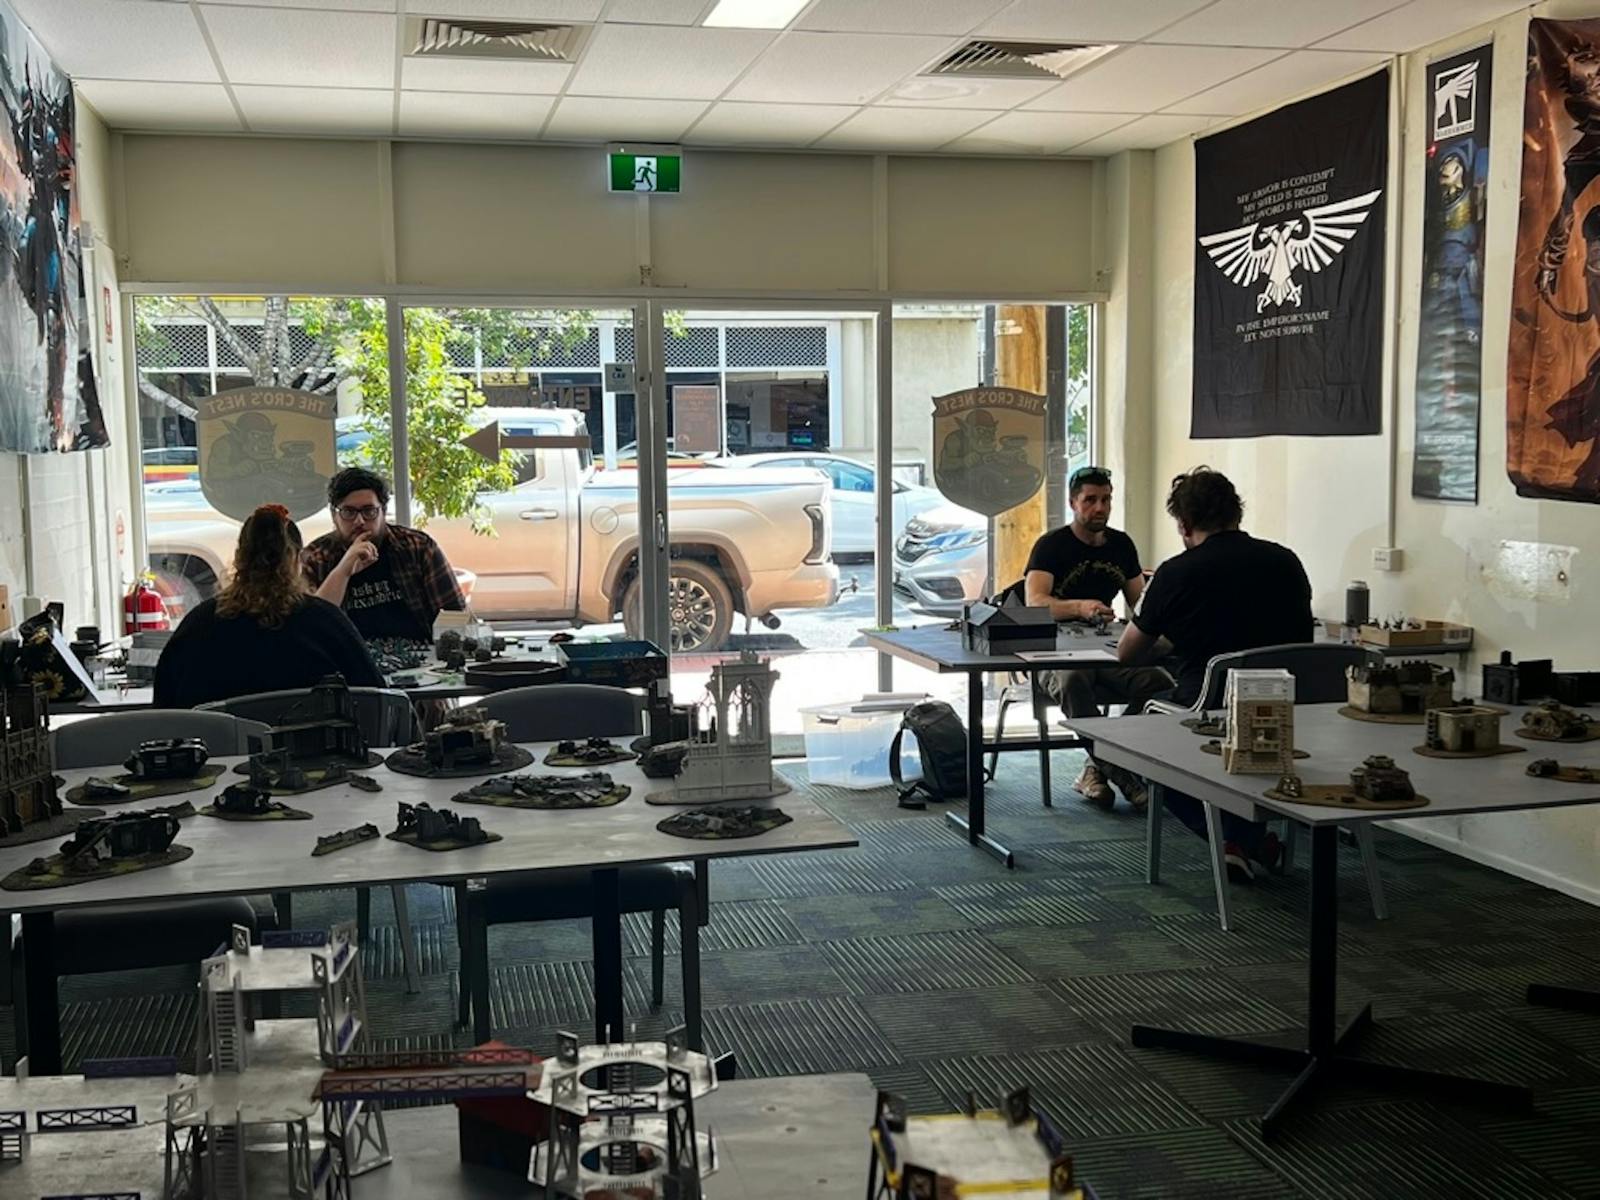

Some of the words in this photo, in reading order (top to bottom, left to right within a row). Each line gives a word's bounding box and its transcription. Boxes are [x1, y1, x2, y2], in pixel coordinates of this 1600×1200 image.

[1282, 180, 1289, 189] IS
[1290, 167, 1335, 187] CONTEMPT
[1243, 202, 1256, 213] MY
[1257, 191, 1284, 209] SHIELD
[1285, 190, 1292, 199] IS
[1293, 181, 1328, 198] DISGUST
[1242, 213, 1255, 225] MY
[1256, 203, 1285, 220] SWORD
[1286, 201, 1293, 211] IS
[1294, 193, 1329, 209] HATRED
[1236, 323, 1245, 333] IN
[1304, 310, 1331, 322] NAME
[1259, 328, 1281, 339] NONE
[1282, 324, 1315, 336] SURVIVE
